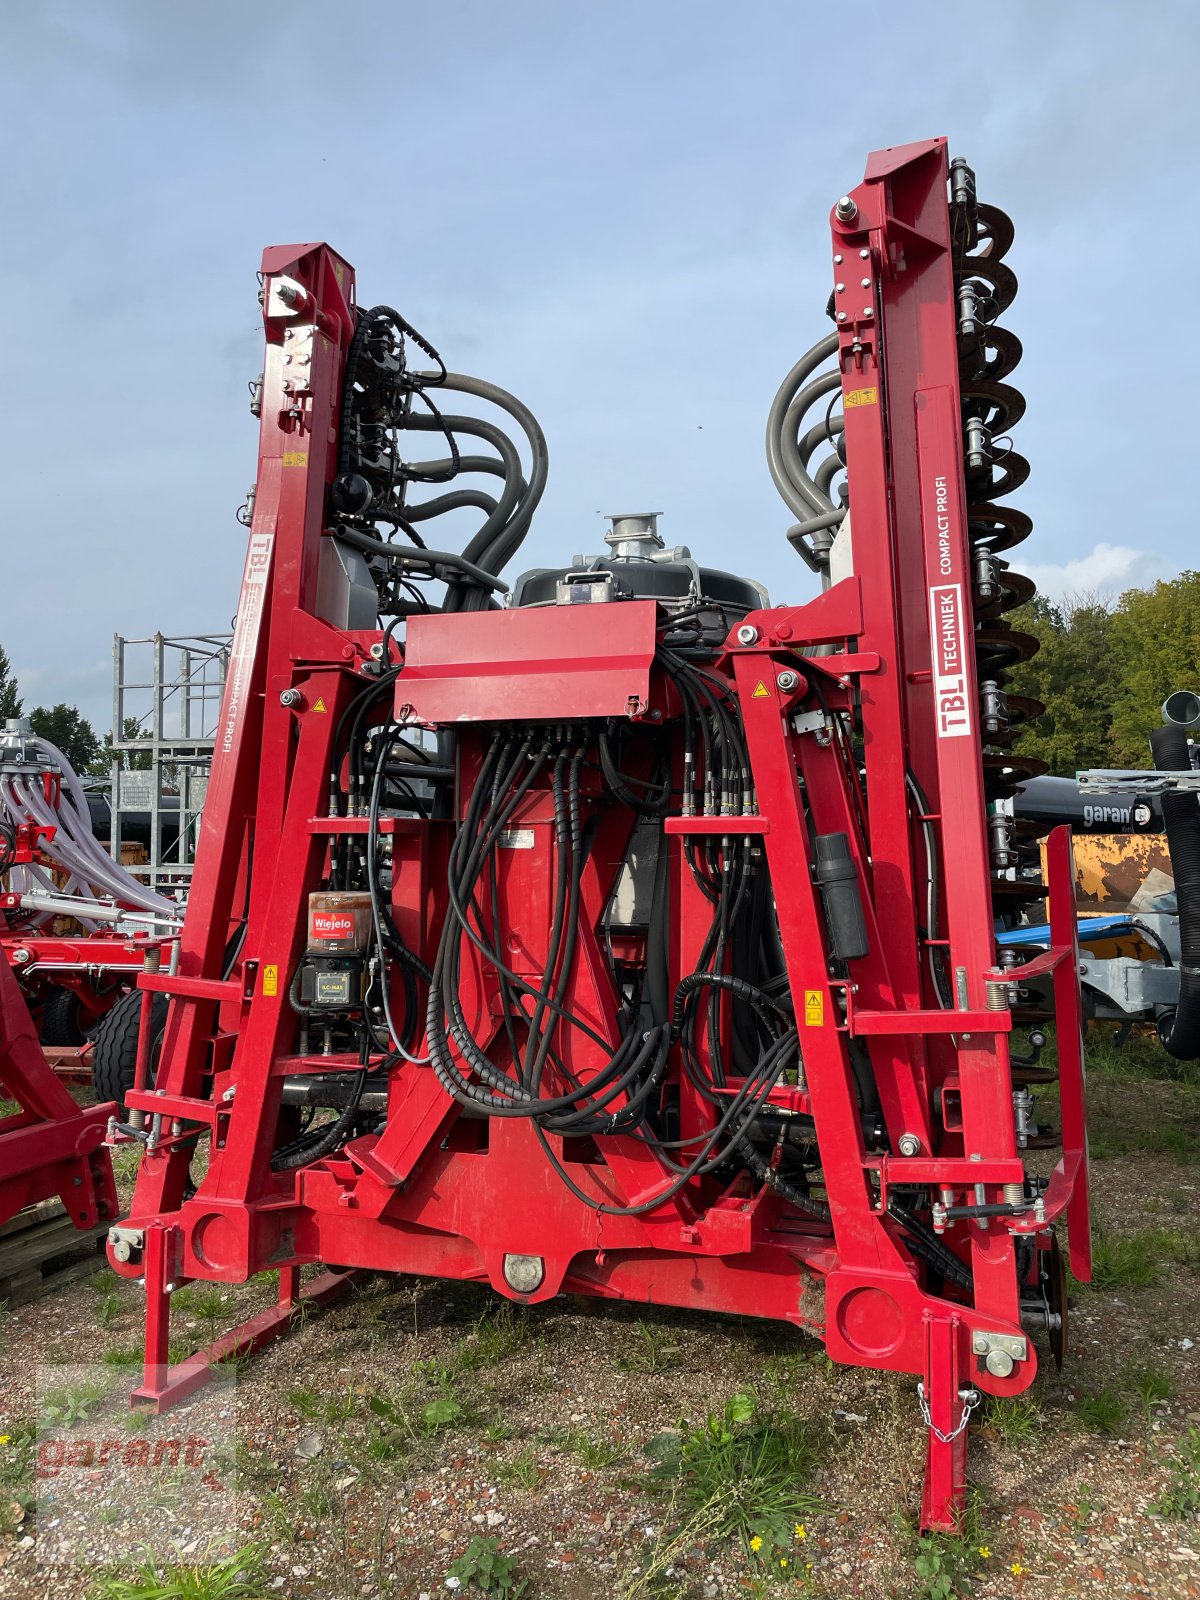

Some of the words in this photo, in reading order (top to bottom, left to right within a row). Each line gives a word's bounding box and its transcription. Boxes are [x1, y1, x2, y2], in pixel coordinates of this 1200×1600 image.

[935, 476, 948, 512] PROFI
[247, 538, 271, 580] TBL
[938, 516, 952, 575] COMPACT
[940, 593, 957, 671] TECHNIEK
[940, 679, 966, 732] TBL
[222, 721, 235, 753] PROFI
[1083, 805, 1132, 827] garan
[315, 918, 351, 930] Wiejelo
